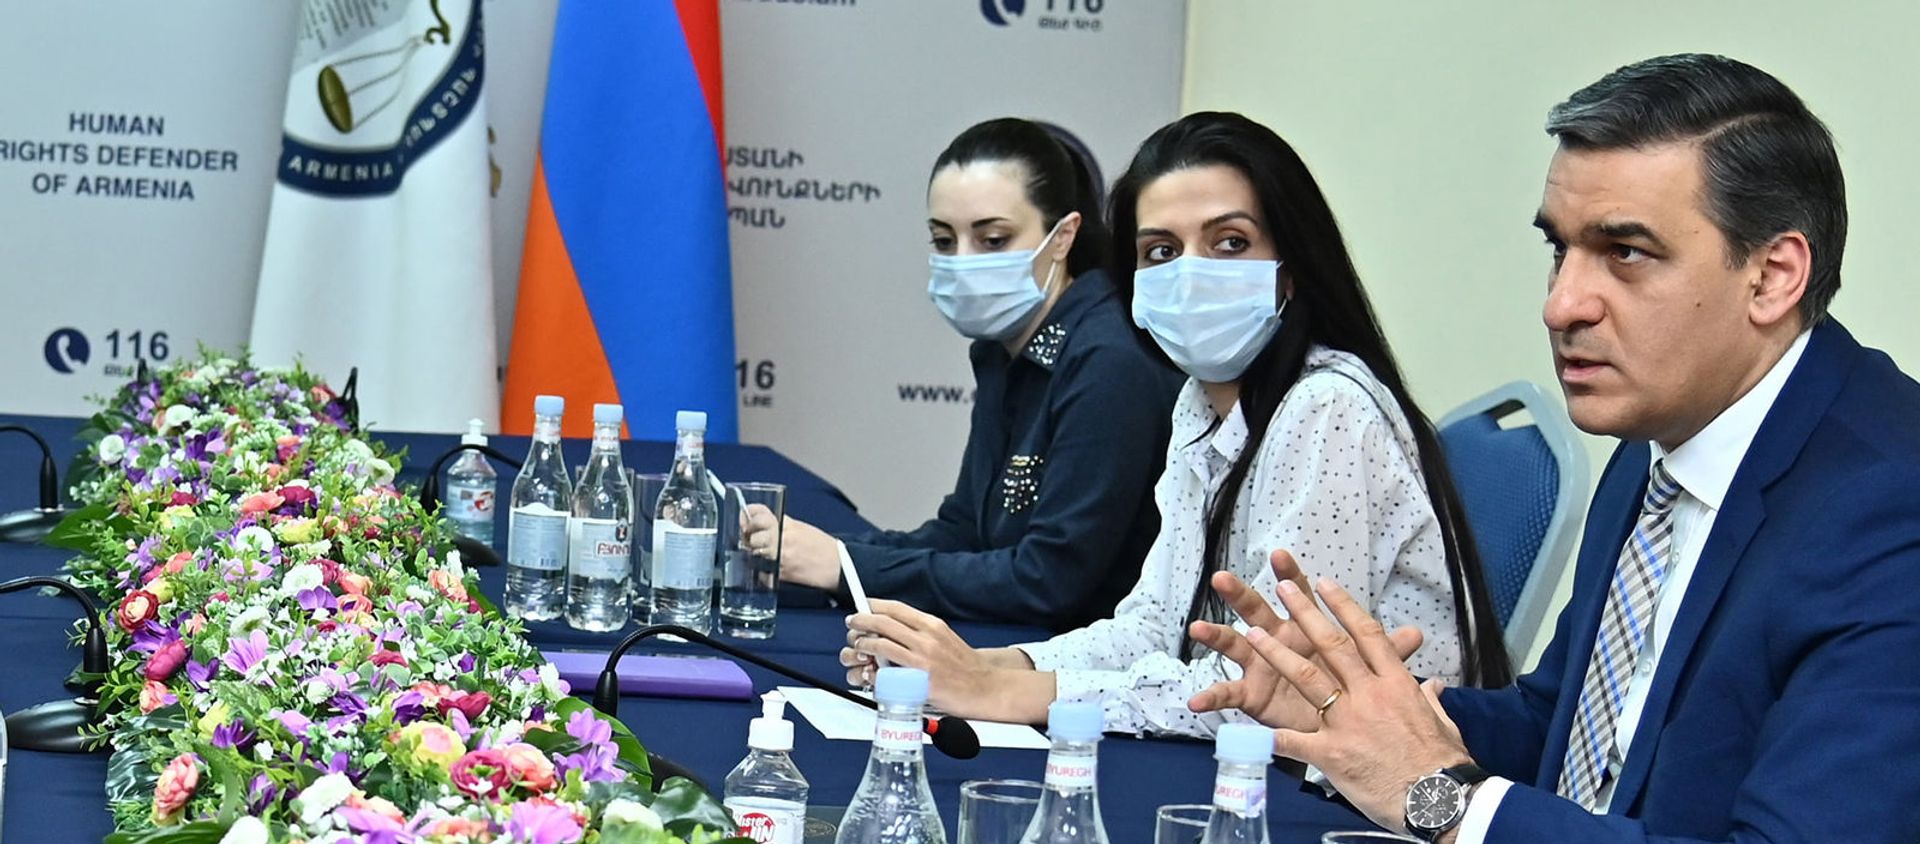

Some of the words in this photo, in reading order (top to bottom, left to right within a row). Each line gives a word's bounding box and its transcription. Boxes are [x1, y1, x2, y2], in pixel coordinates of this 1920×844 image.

[68, 112, 165, 136] HUMAN
[0, 139, 89, 165] RIGHTS
[97, 145, 239, 172] DEFENDER
[287, 154, 394, 182] ARMENIA
[32, 172, 67, 195] OF
[75, 175, 196, 201] ARMENIA
[106, 329, 169, 361] 116
